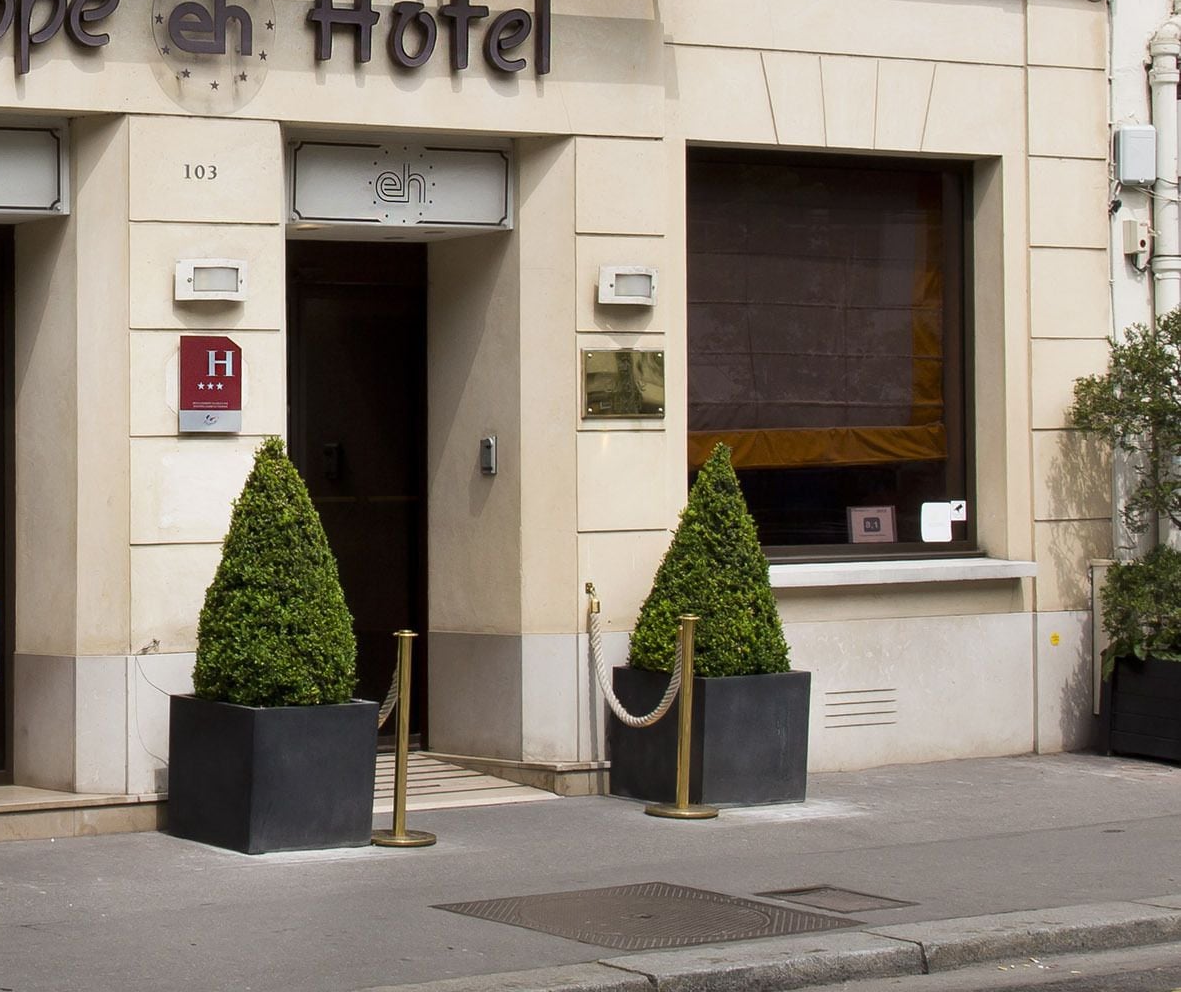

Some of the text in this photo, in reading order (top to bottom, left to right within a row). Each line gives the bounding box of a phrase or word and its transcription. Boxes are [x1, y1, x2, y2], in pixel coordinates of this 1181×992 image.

[183, 164, 218, 180] 103
[375, 163, 426, 203] eh
[206, 350, 235, 377] H
